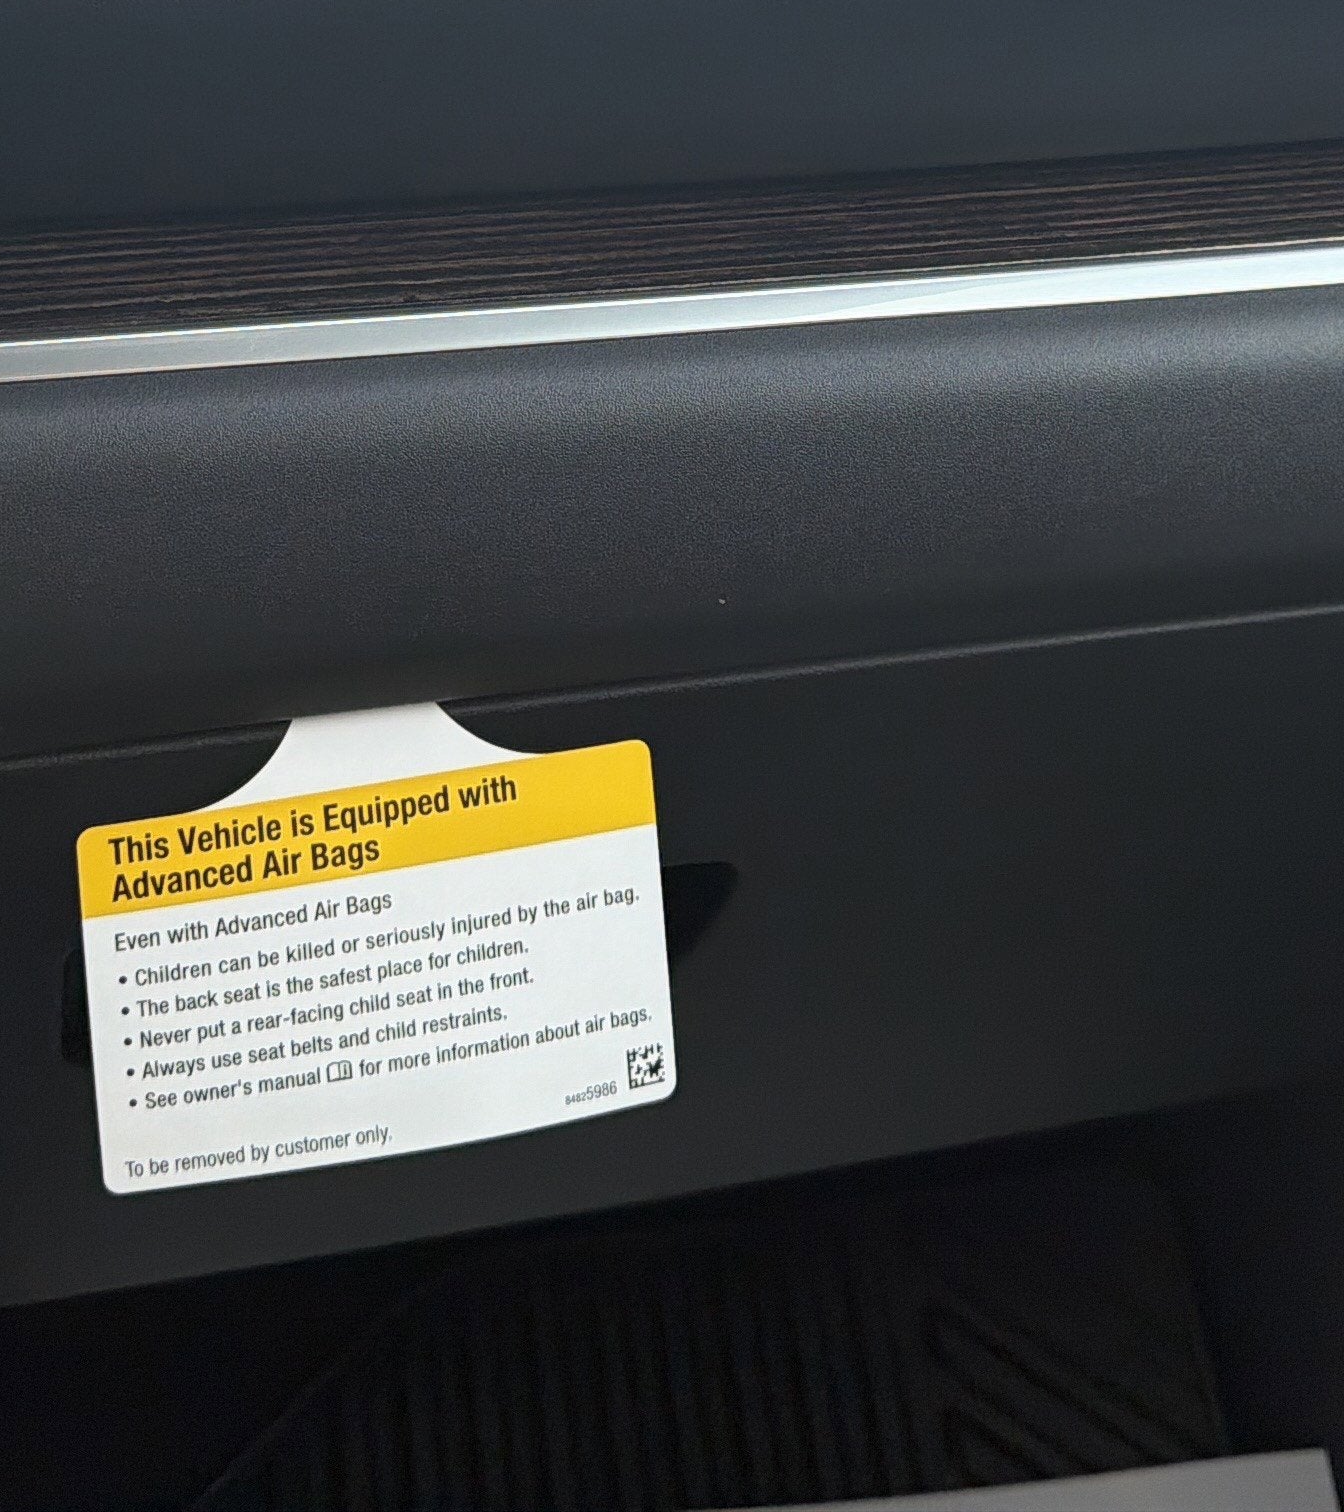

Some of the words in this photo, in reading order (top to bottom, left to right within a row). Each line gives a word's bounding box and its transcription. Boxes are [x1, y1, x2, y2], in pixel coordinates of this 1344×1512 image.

[108, 832, 169, 865] This
[177, 815, 281, 855] Vehicle
[290, 809, 314, 838] is
[323, 785, 450, 834] Equipped
[458, 775, 517, 809] with
[112, 854, 253, 903] Advanced
[262, 848, 302, 879] Air
[310, 840, 380, 871] Bags
[114, 931, 161, 952] Even
[167, 921, 209, 944] with
[215, 904, 308, 937] Advanced
[314, 899, 340, 921] Air
[346, 894, 392, 915] Bags
[135, 963, 212, 987] Children
[218, 956, 251, 974] can
[257, 950, 279, 968] be
[286, 938, 335, 963] killed
[341, 938, 360, 954] or
[366, 921, 445, 950] seriously
[451, 907, 512, 936] injured
[518, 905, 537, 925] by
[543, 900, 570, 917] the
[577, 892, 598, 911] air
[603, 888, 639, 906] bag.
[136, 999, 169, 1017] The
[175, 990, 219, 1012] back
[223, 983, 262, 1005] seat
[266, 980, 281, 998] is
[286, 976, 313, 995] the
[320, 964, 372, 989] safest
[377, 959, 422, 983] place
[428, 952, 451, 970] for
[457, 940, 528, 965] children.
[140, 1028, 192, 1048] Never
[197, 1020, 226, 1044] put
[231, 1021, 242, 1035] a
[247, 1003, 344, 1033] rear-facing
[349, 992, 390, 1015] child
[396, 985, 433, 1007] seat
[437, 982, 452, 1000] in
[458, 978, 484, 996] the
[489, 967, 533, 990] front.
[142, 1057, 205, 1079] Always
[211, 1052, 242, 1070] use
[248, 1042, 286, 1063] seat
[290, 1036, 333, 1057] belts
[339, 1027, 370, 1049] and
[376, 1019, 416, 1043] child
[423, 1006, 507, 1035] restraints.
[145, 1092, 177, 1109] See
[183, 1079, 253, 1104] owner's
[258, 1067, 321, 1093] manual
[359, 1059, 382, 1077] for
[388, 1052, 430, 1072] more
[436, 1033, 530, 1064] information
[536, 1020, 580, 1044] about
[585, 1014, 605, 1034] air
[610, 1009, 652, 1029] bags.
[125, 1161, 144, 1177] To
[149, 1158, 169, 1175] be
[175, 1146, 245, 1173] removed
[250, 1144, 270, 1164] by
[275, 1133, 351, 1157] customer
[356, 1125, 392, 1145] only.
